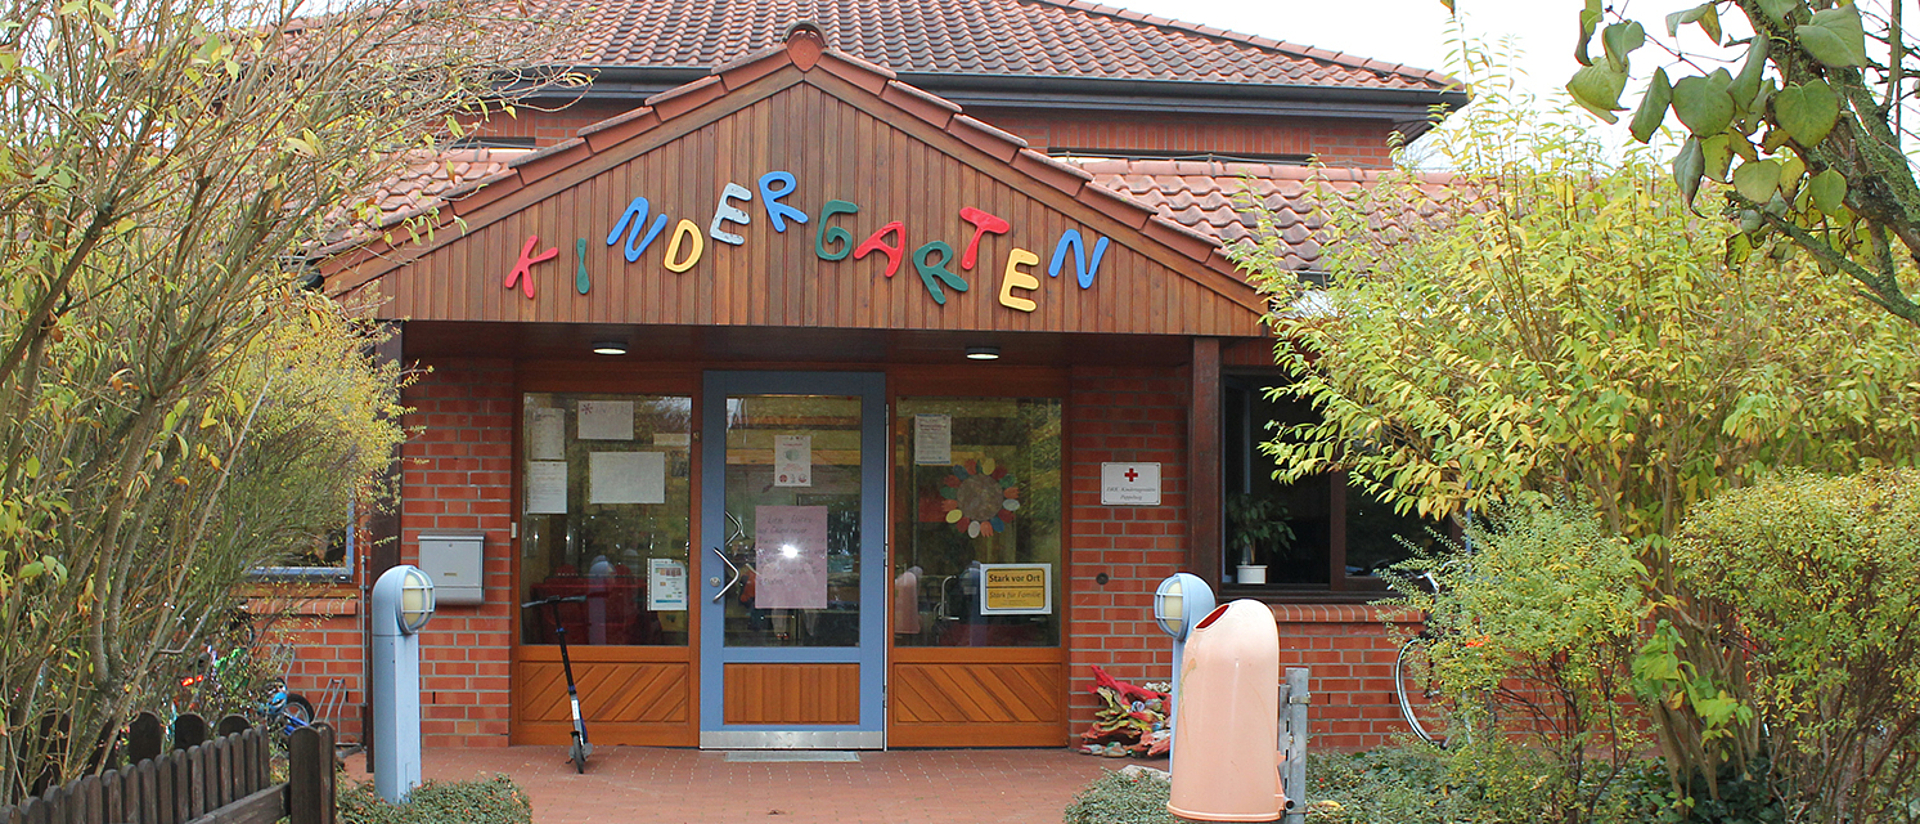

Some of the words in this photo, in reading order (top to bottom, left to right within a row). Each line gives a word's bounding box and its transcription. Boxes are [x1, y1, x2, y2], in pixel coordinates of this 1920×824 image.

[505, 171, 1108, 312] KINDERGARTEN
[989, 574, 1010, 582] Stark
[1026, 574, 1041, 582] Ort
